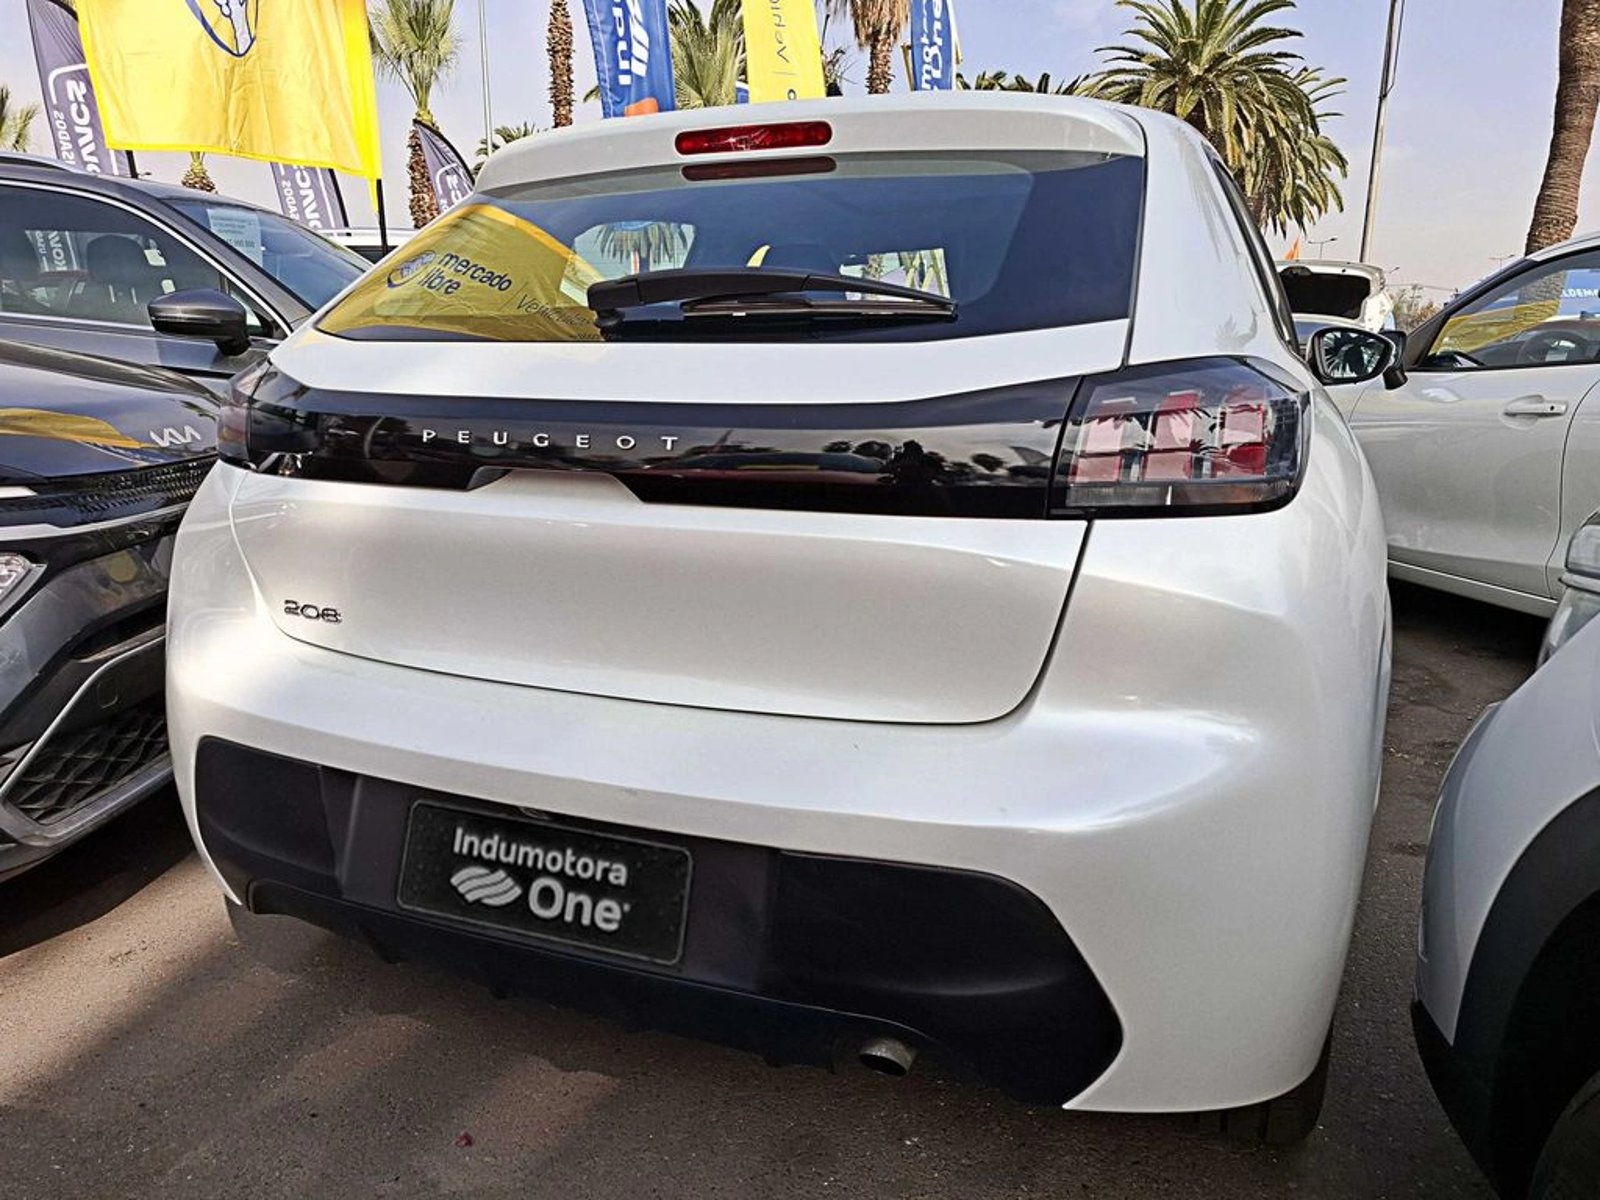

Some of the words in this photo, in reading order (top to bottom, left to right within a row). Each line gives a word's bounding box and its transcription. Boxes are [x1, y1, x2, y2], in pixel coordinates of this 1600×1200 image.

[612, 0, 632, 85] Ind
[417, 267, 462, 295] libre
[437, 252, 513, 292] mercado
[421, 429, 679, 451] PEUGEOT
[283, 599, 343, 624] 208
[452, 826, 629, 887] Indumotora
[527, 876, 623, 932] One
